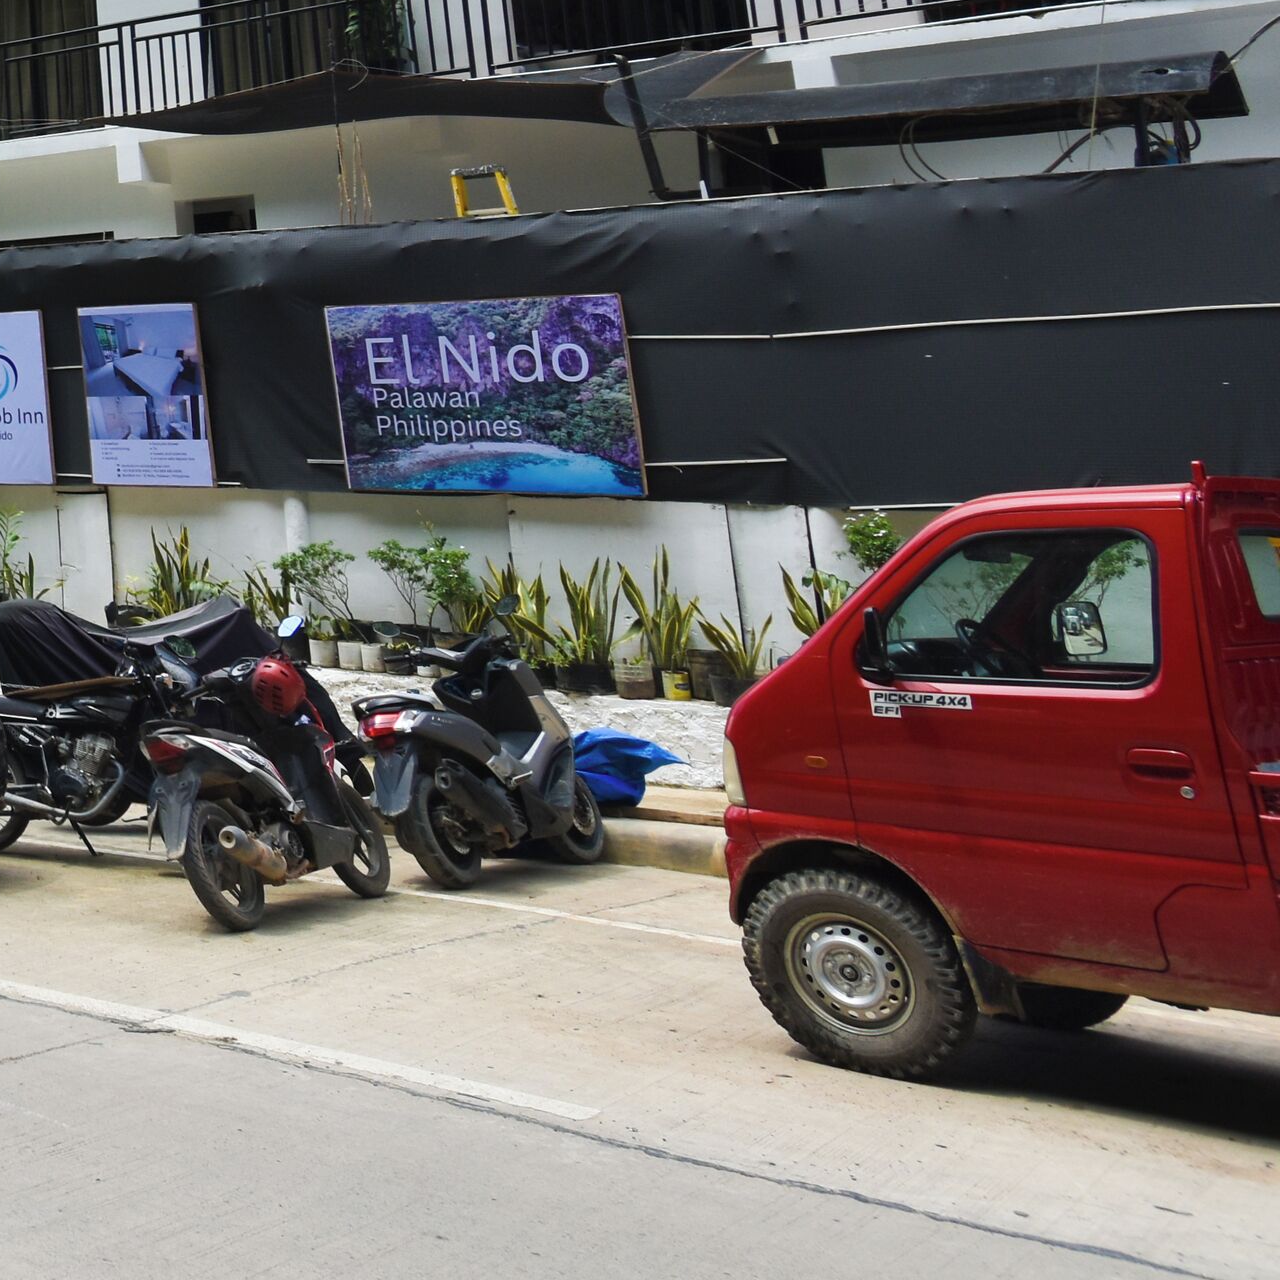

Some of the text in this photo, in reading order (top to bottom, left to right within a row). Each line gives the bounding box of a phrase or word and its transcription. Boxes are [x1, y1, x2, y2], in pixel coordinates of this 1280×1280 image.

[365, 330, 590, 385] El Nido
[373, 388, 480, 409] Palawan
[18, 408, 44, 425] Inn
[376, 415, 522, 442] Philippines
[874, 692, 934, 704] PICK-UP
[874, 705, 900, 715] EFI
